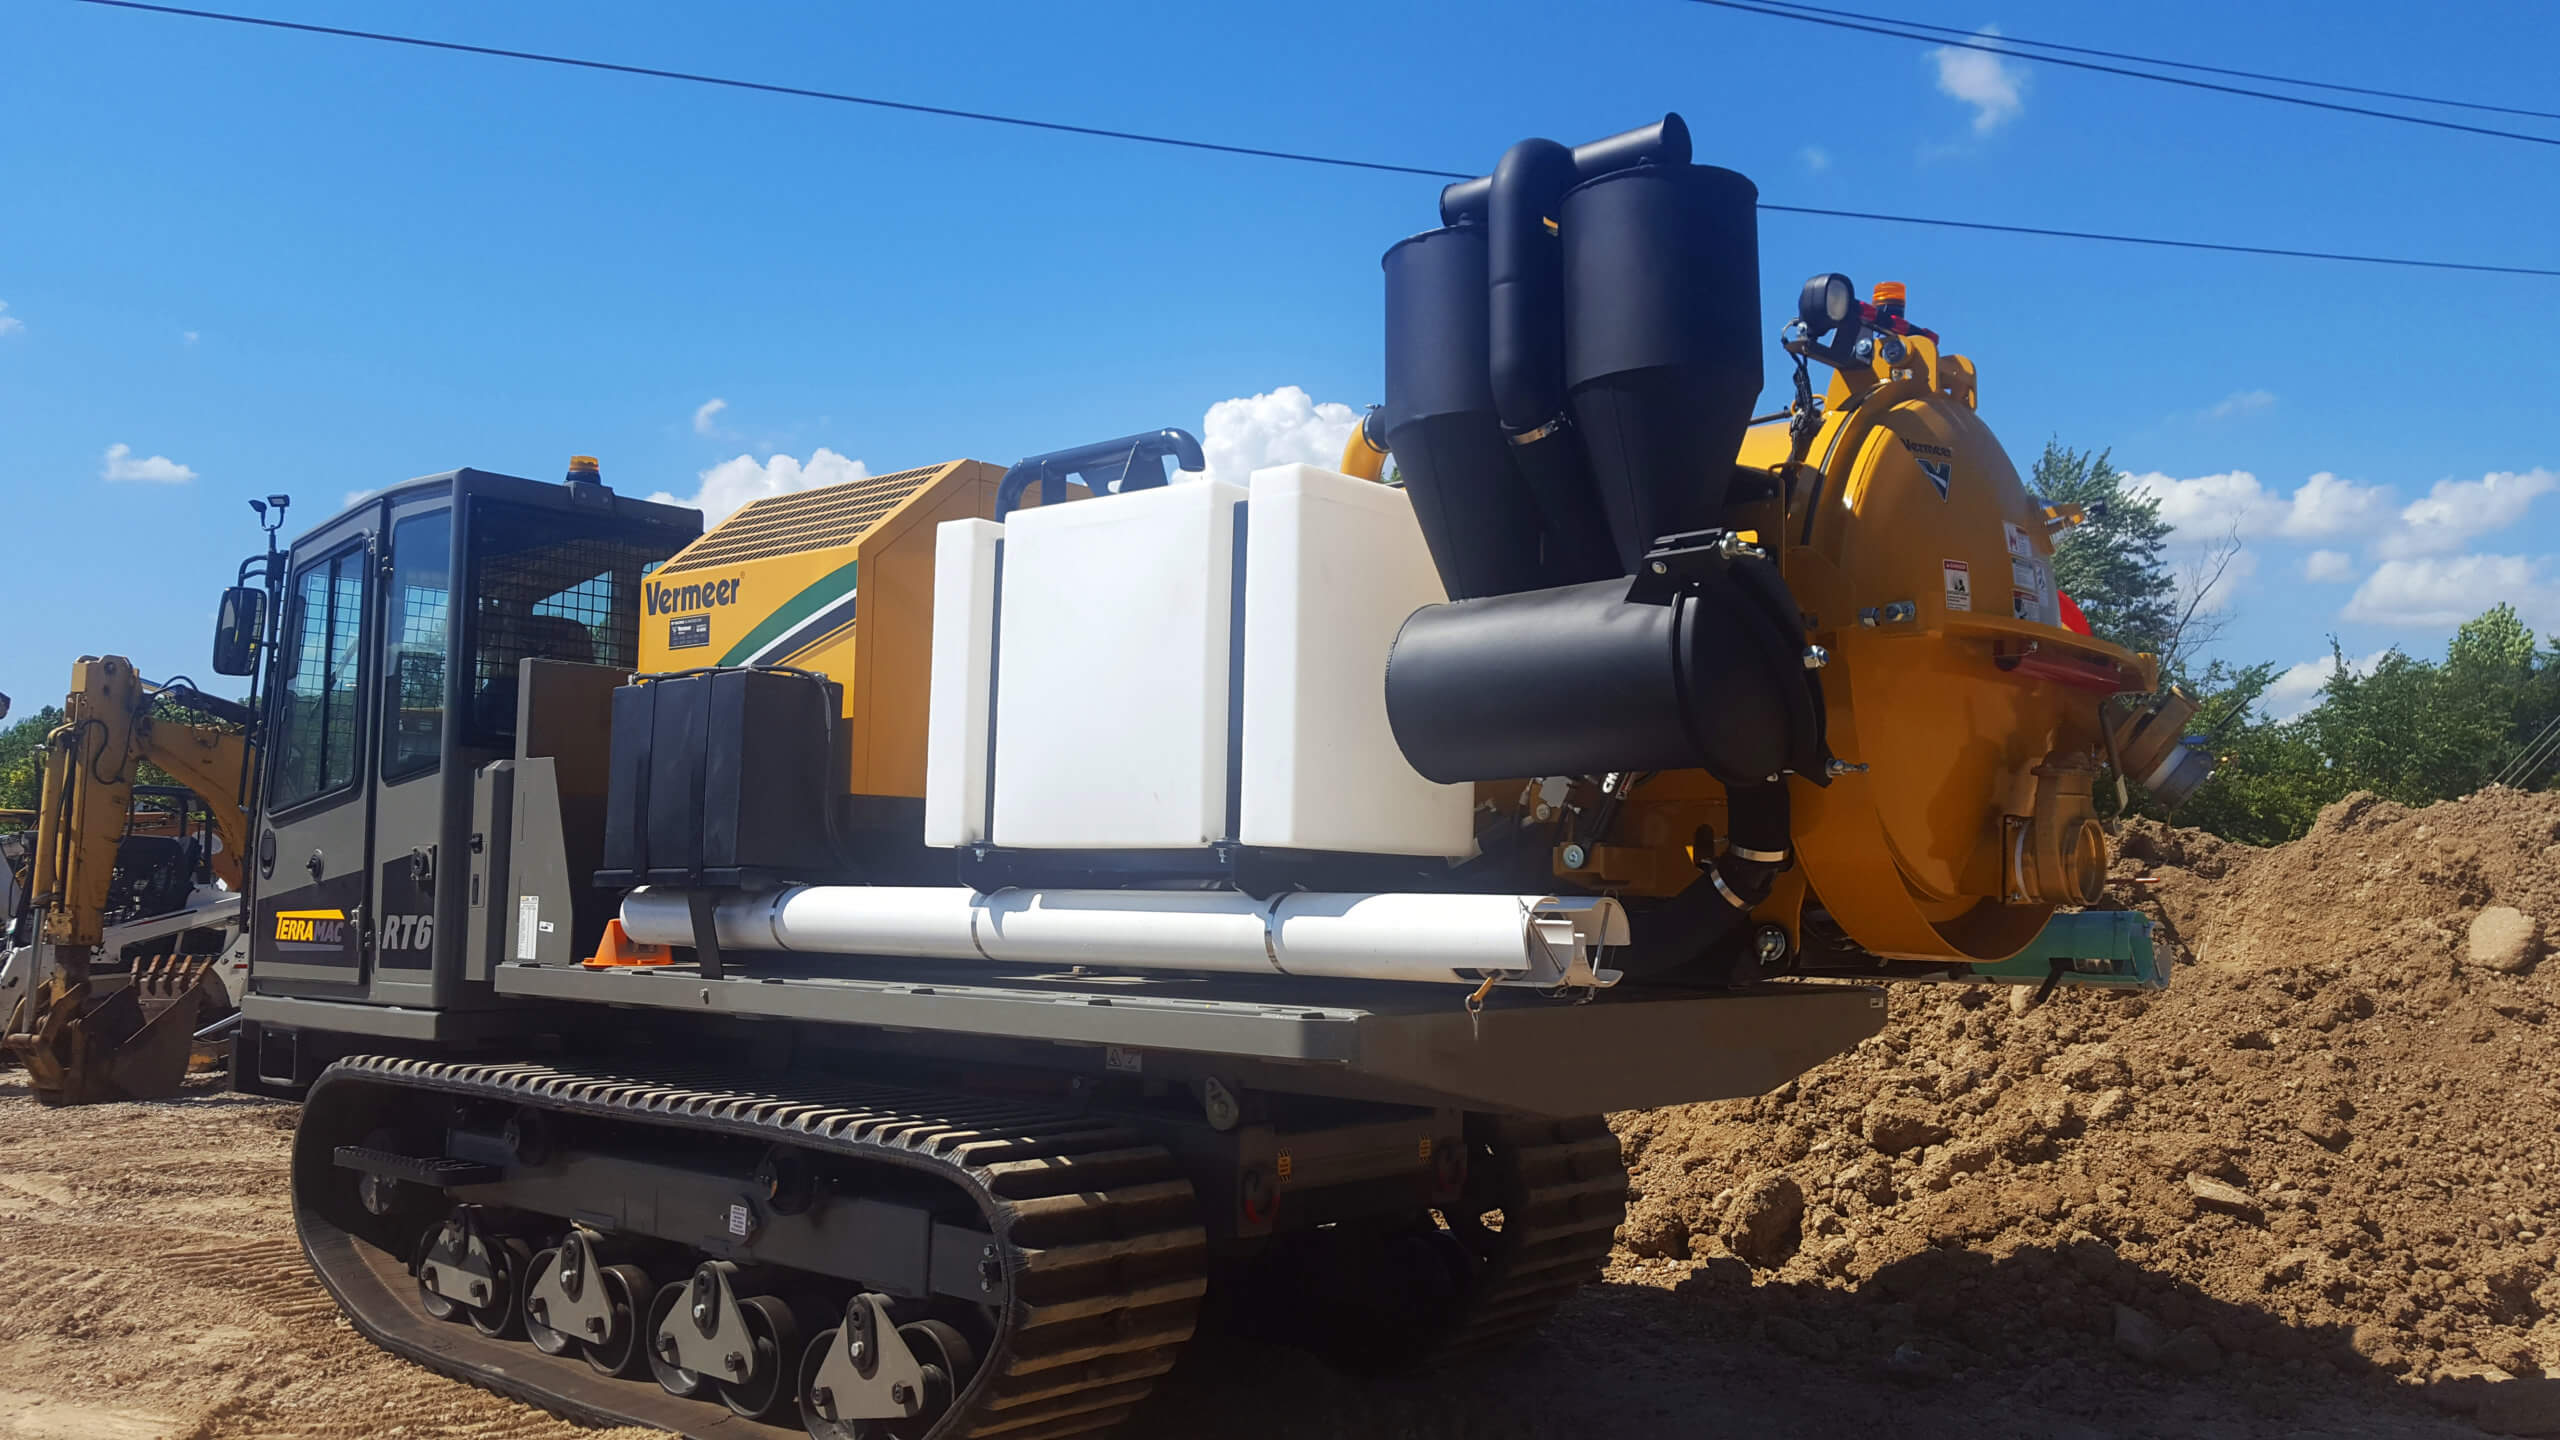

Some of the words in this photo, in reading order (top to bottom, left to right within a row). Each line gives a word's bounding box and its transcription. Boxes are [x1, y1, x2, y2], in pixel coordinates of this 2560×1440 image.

[645, 577, 740, 616] Vermeer
[275, 909, 345, 942] TERRAMAC
[382, 914, 433, 950] RT6
